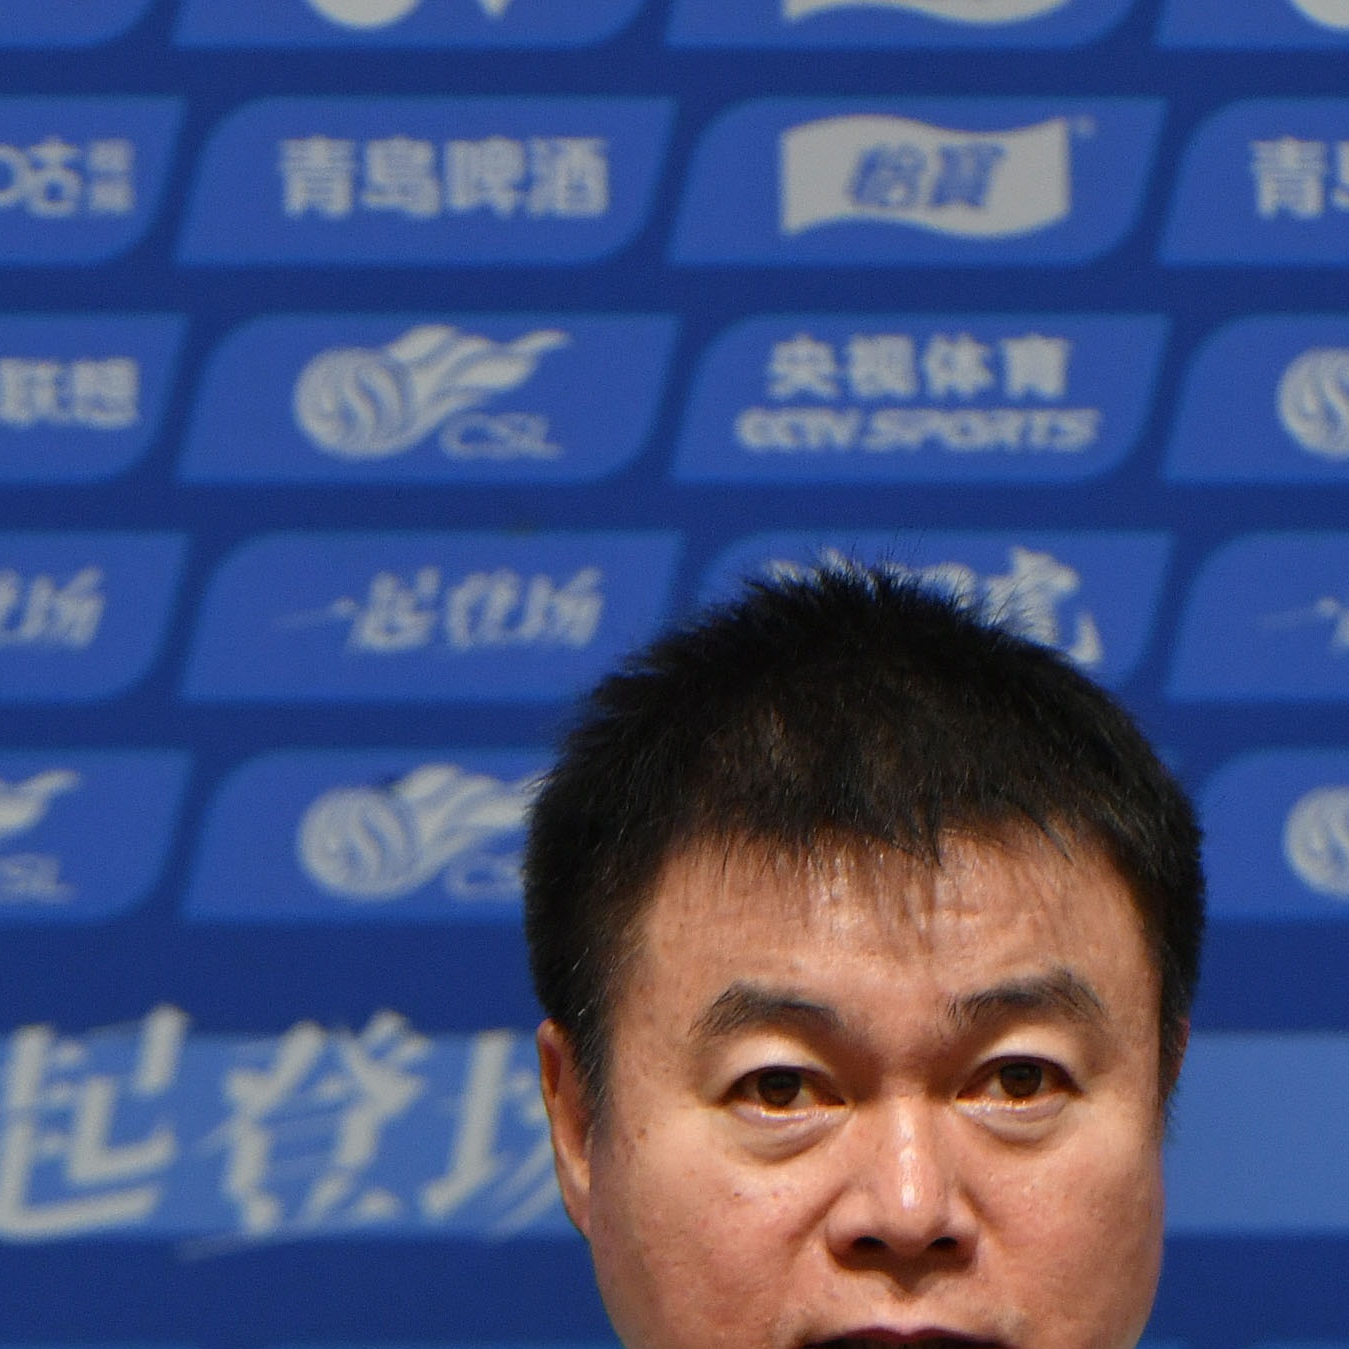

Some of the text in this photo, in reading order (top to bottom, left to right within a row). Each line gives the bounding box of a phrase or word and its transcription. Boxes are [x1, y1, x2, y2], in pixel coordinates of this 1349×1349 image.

[280, 136, 609, 217] 青岛啤酒
[768, 334, 1069, 399] 央视体育
[439, 411, 563, 458] CSL
[735, 407, 1100, 451] CCTV SPORTS
[447, 854, 523, 900] CS
